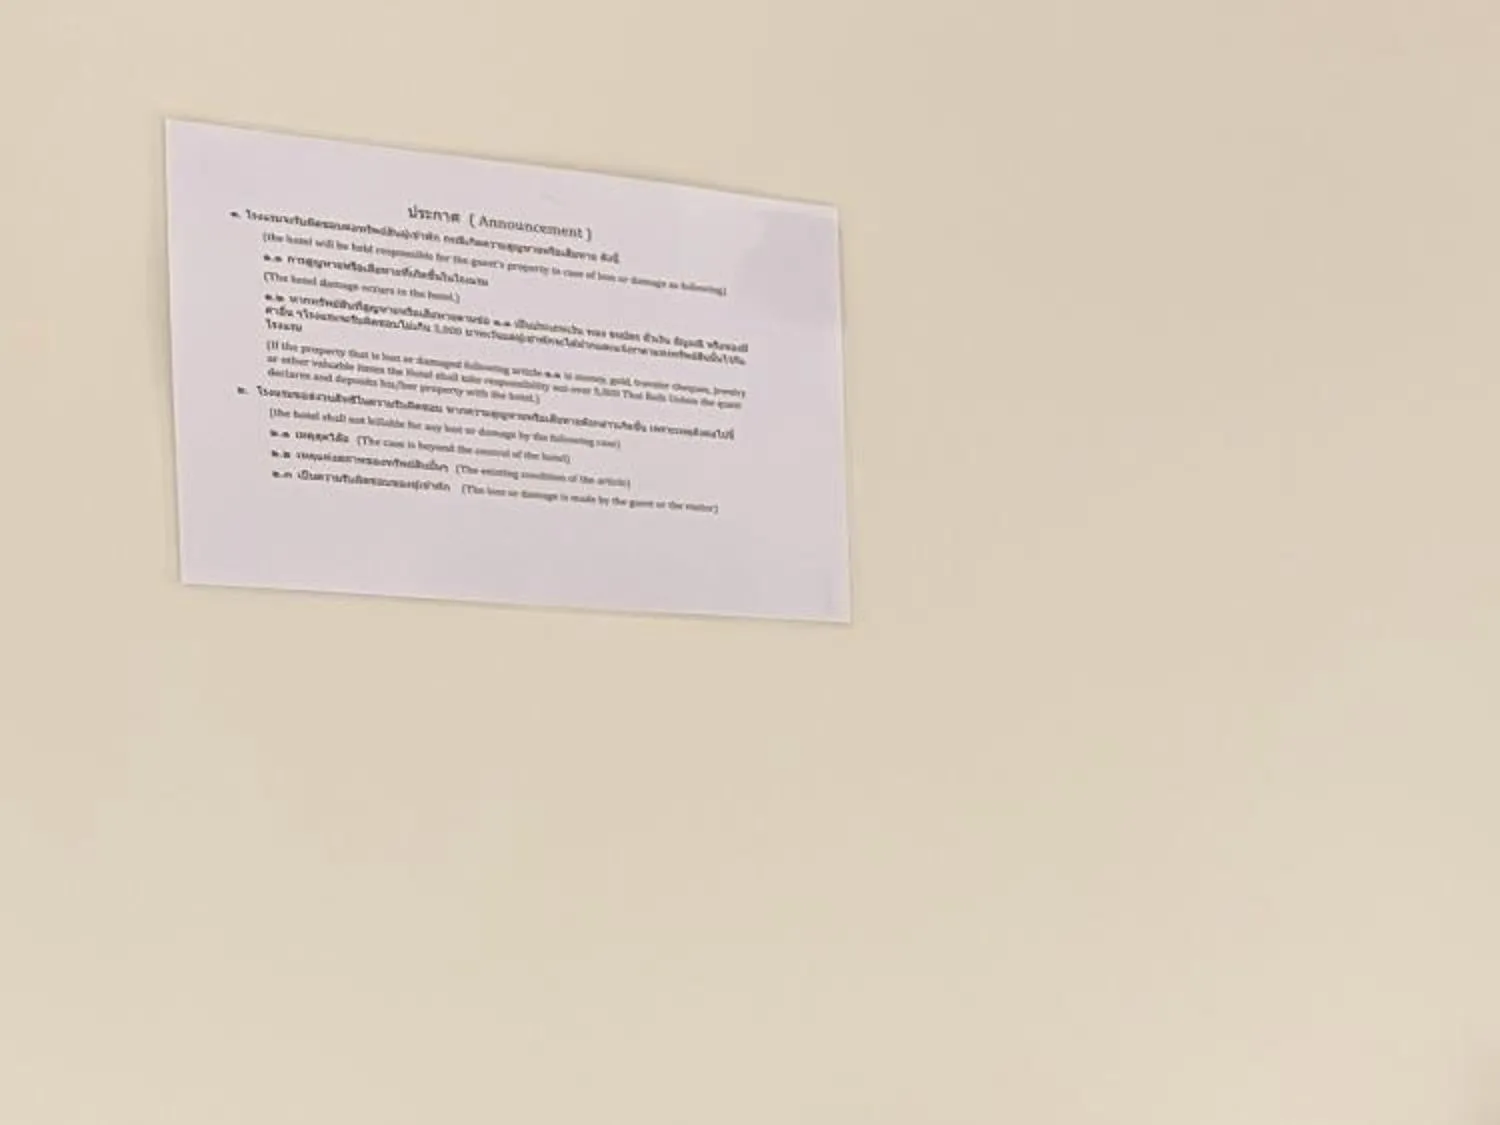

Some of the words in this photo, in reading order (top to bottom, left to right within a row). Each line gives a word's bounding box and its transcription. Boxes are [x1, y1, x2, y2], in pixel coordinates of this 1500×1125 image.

[407, 204, 460, 222] ประกาศ
[478, 214, 583, 239] Announcement
